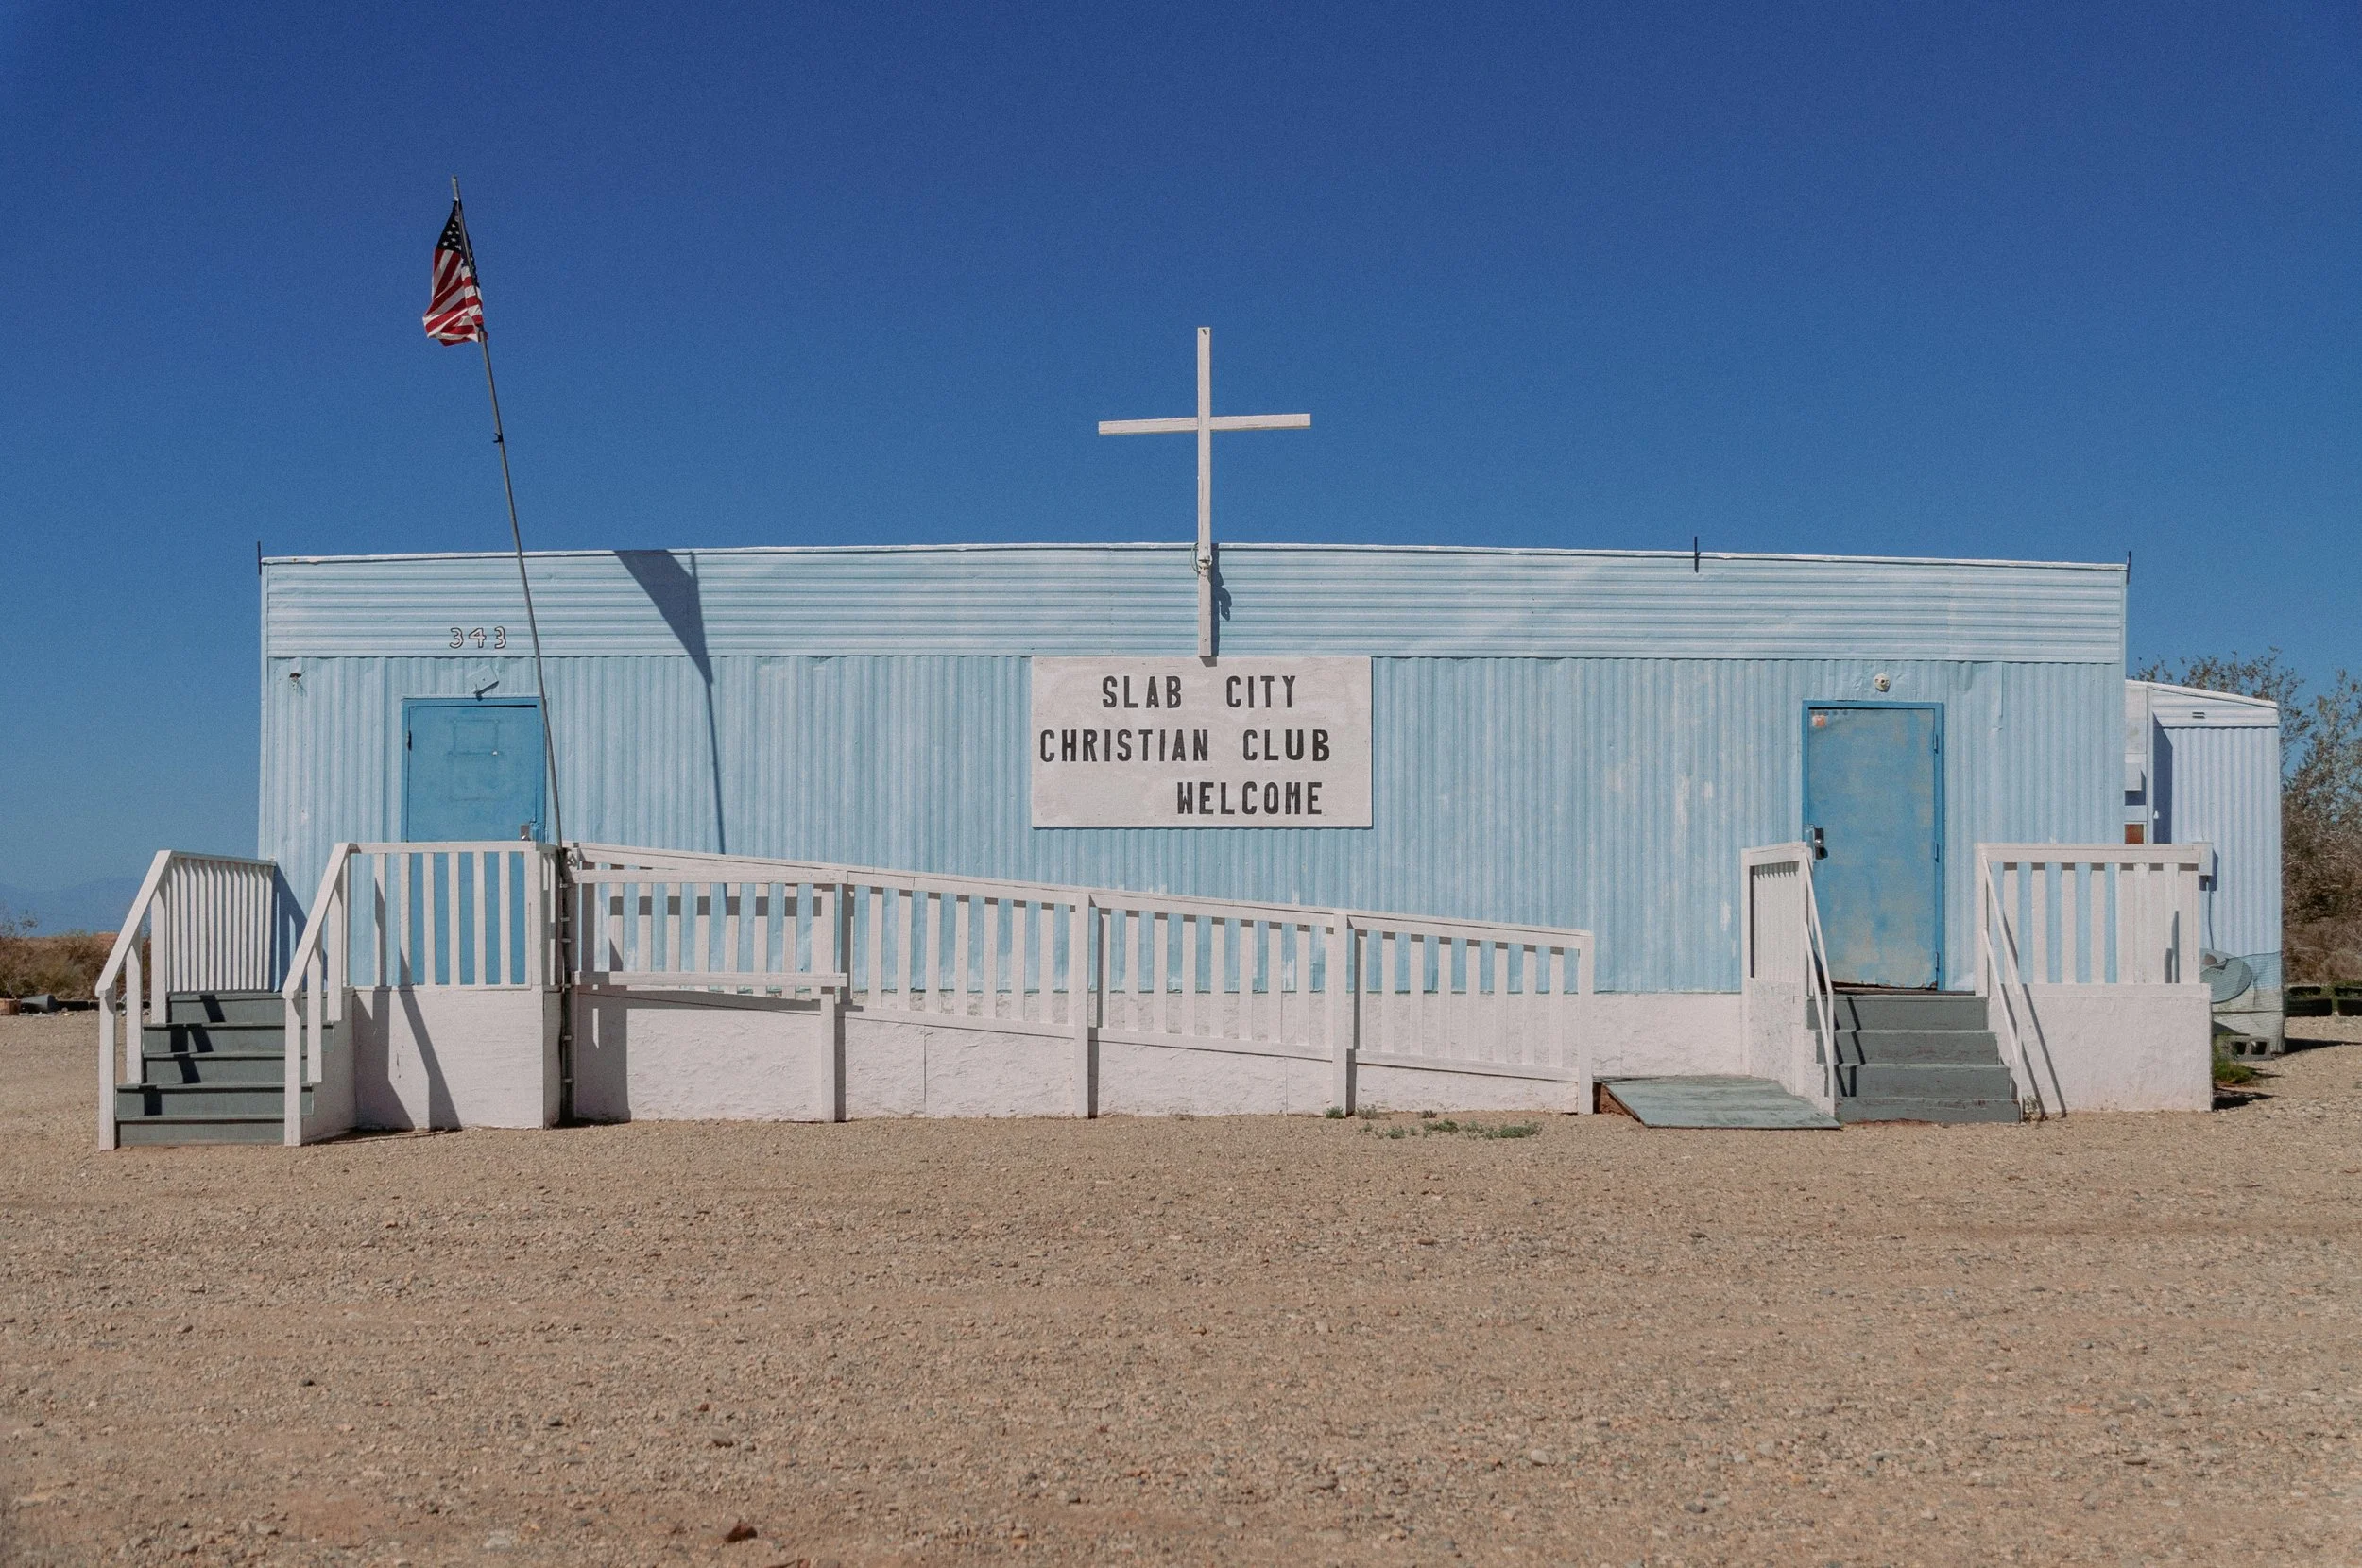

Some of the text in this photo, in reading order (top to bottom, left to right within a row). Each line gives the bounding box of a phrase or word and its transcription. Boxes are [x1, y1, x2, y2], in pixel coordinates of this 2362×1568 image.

[450, 627, 506, 649] 343
[1103, 676, 1295, 708] SLAB CITY
[1040, 729, 1329, 762] CHRISTIAN CLUB
[1177, 781, 1322, 814] WELCOME
